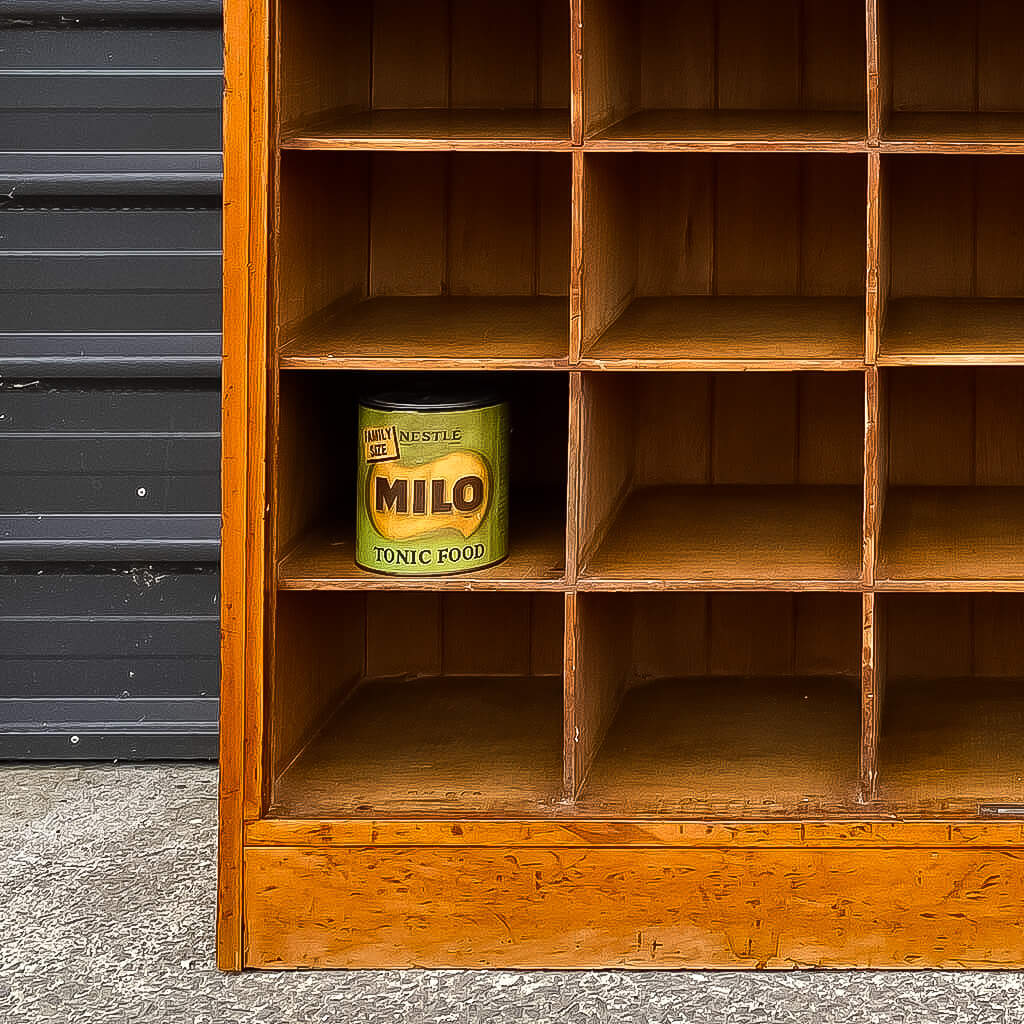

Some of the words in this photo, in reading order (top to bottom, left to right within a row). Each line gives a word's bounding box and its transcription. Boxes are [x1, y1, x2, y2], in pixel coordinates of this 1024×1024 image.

[364, 426, 392, 443] FAMILY
[369, 443, 388, 457] SIZE
[375, 475, 484, 514] MILO
[373, 546, 432, 565] TONIC
[437, 543, 485, 564] FOOD
